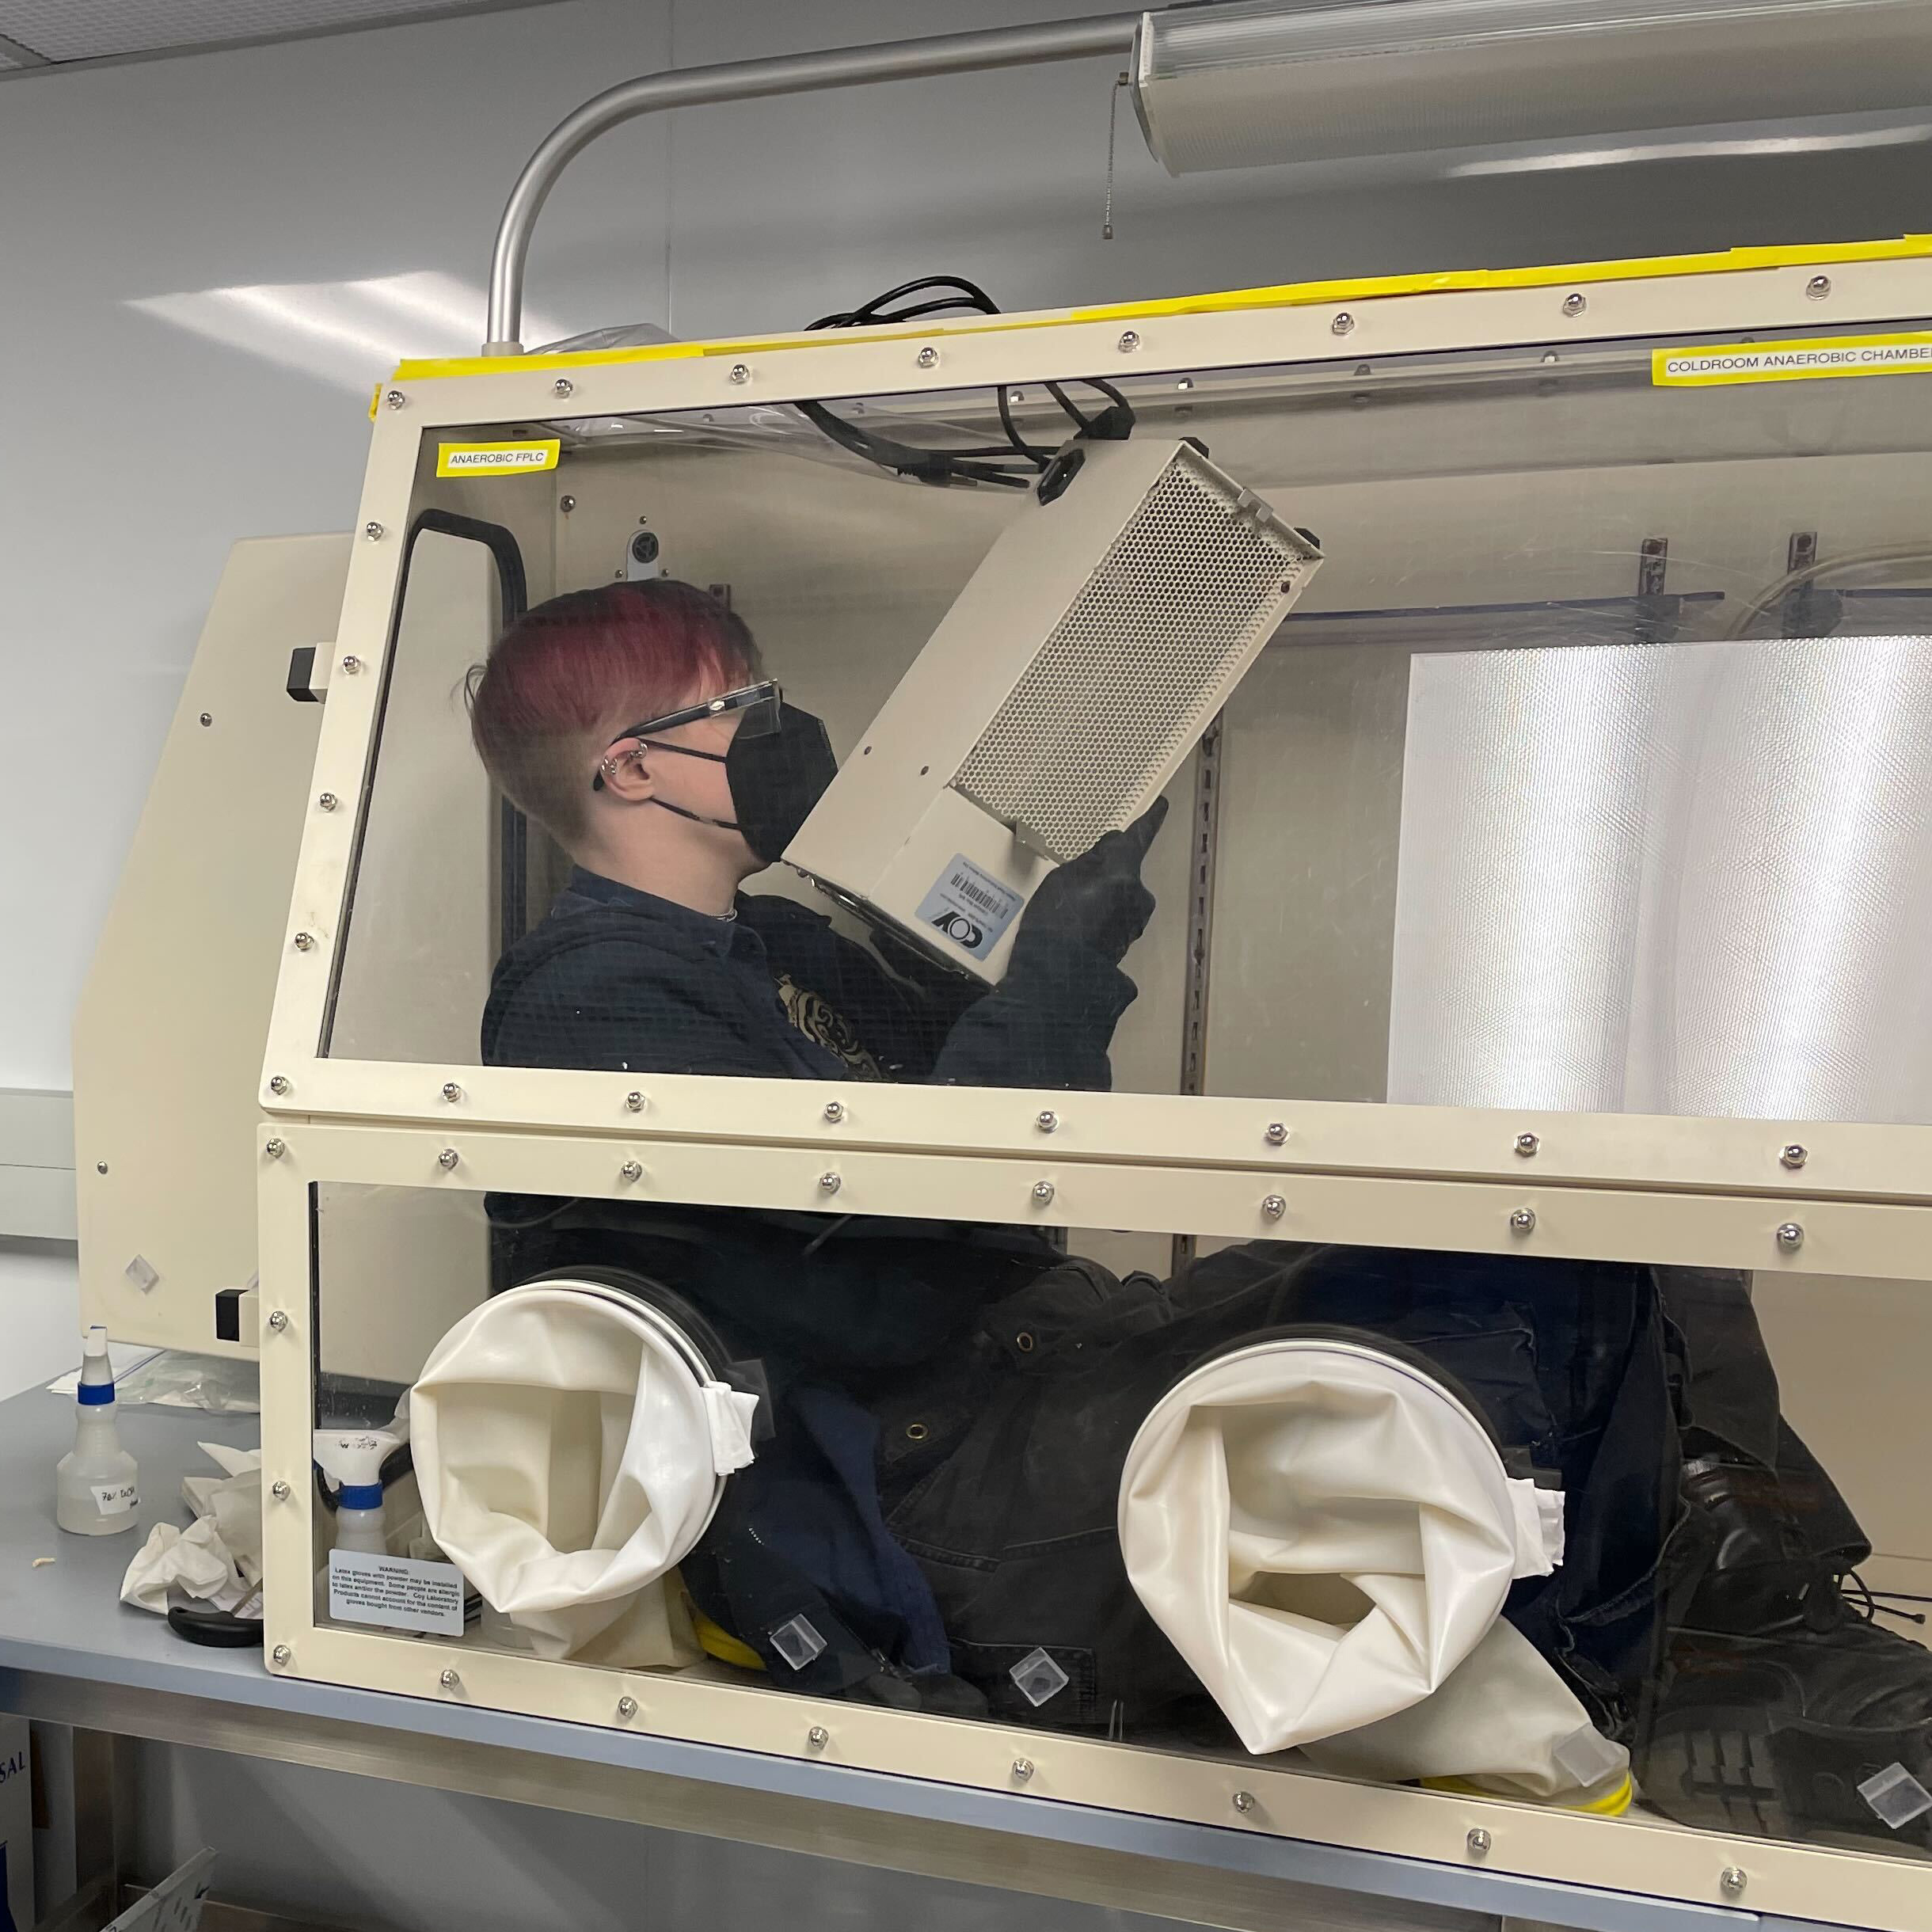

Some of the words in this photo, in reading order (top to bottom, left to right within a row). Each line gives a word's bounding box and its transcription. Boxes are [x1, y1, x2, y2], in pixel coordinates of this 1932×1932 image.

[1668, 356, 1759, 373] COLDROOM
[1763, 351, 1857, 367] ANAEROBIC
[1861, 348, 1932, 362] CHAMBE
[451, 453, 513, 464] ANAEROBIC
[515, 452, 544, 462] FPLC
[931, 911, 983, 949] COY
[333, 1588, 359, 1597] Products
[426, 1594, 458, 1605] Laboratory
